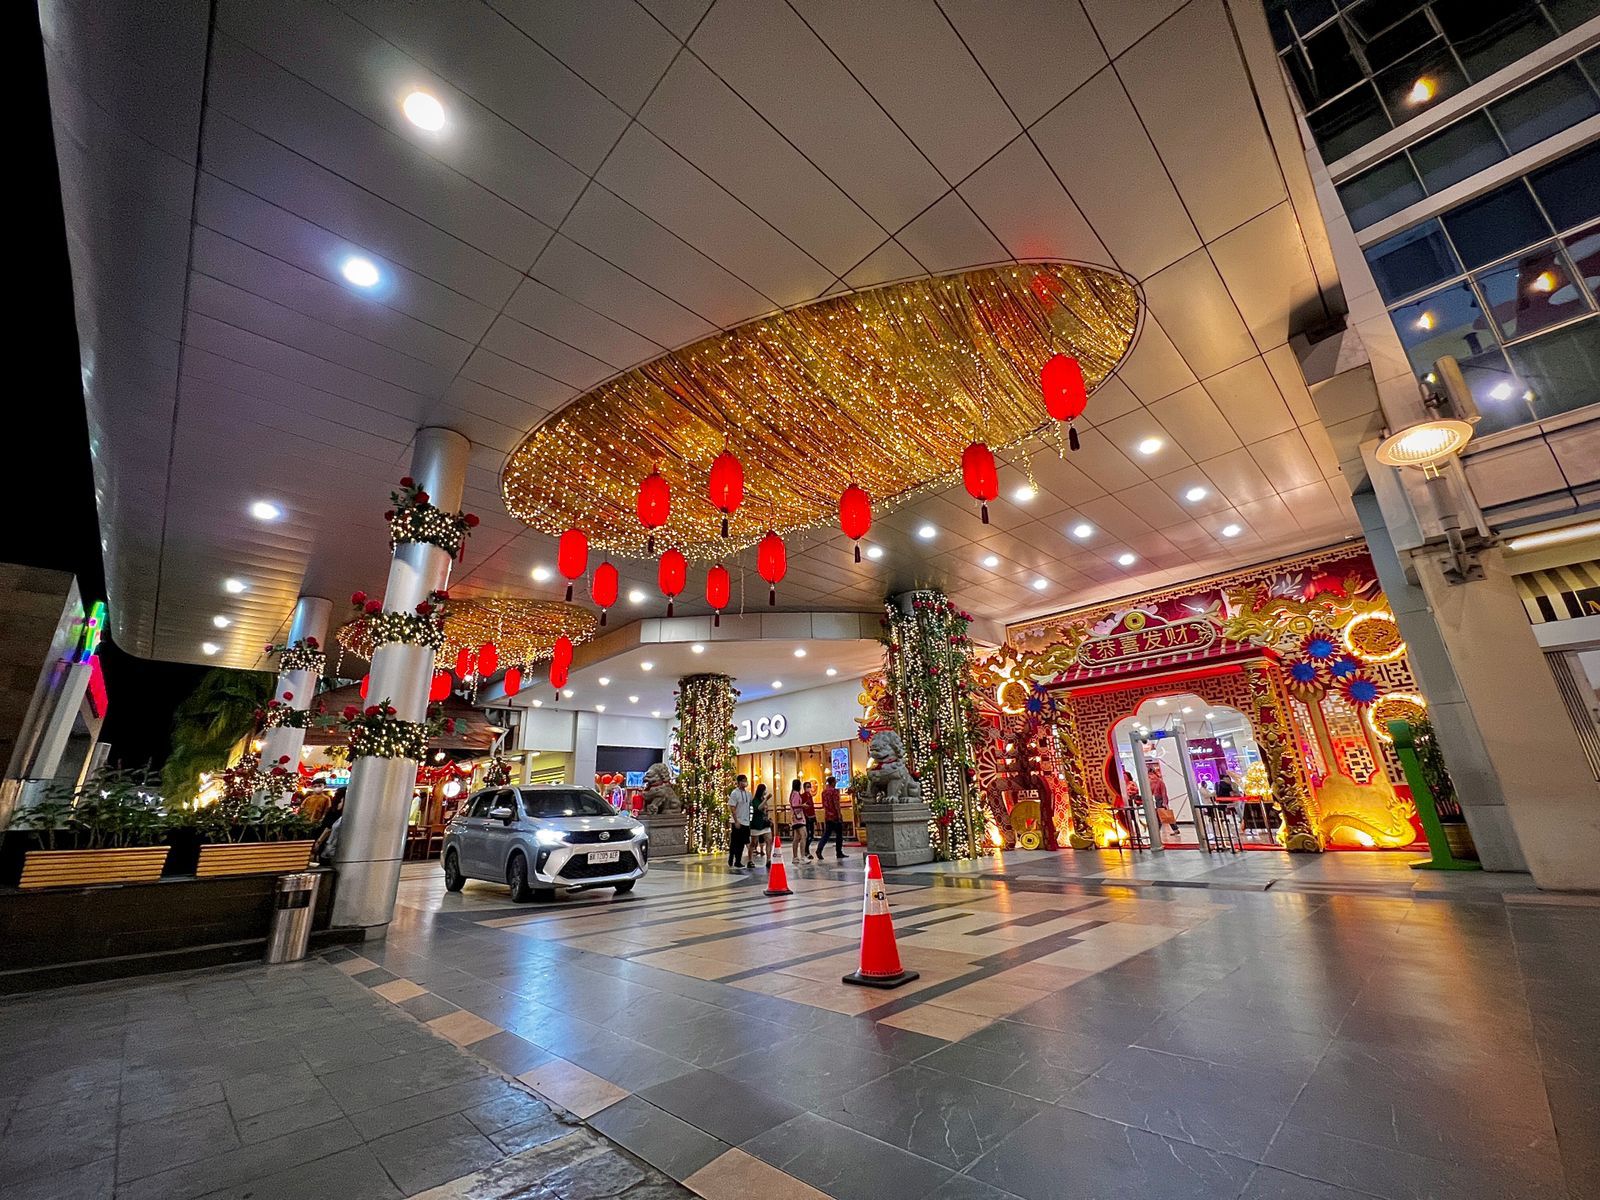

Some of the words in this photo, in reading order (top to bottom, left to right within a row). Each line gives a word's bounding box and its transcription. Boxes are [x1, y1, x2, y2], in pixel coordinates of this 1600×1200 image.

[1096, 624, 1189, 659] 恭喜发财
[737, 713, 787, 743] J.CO
